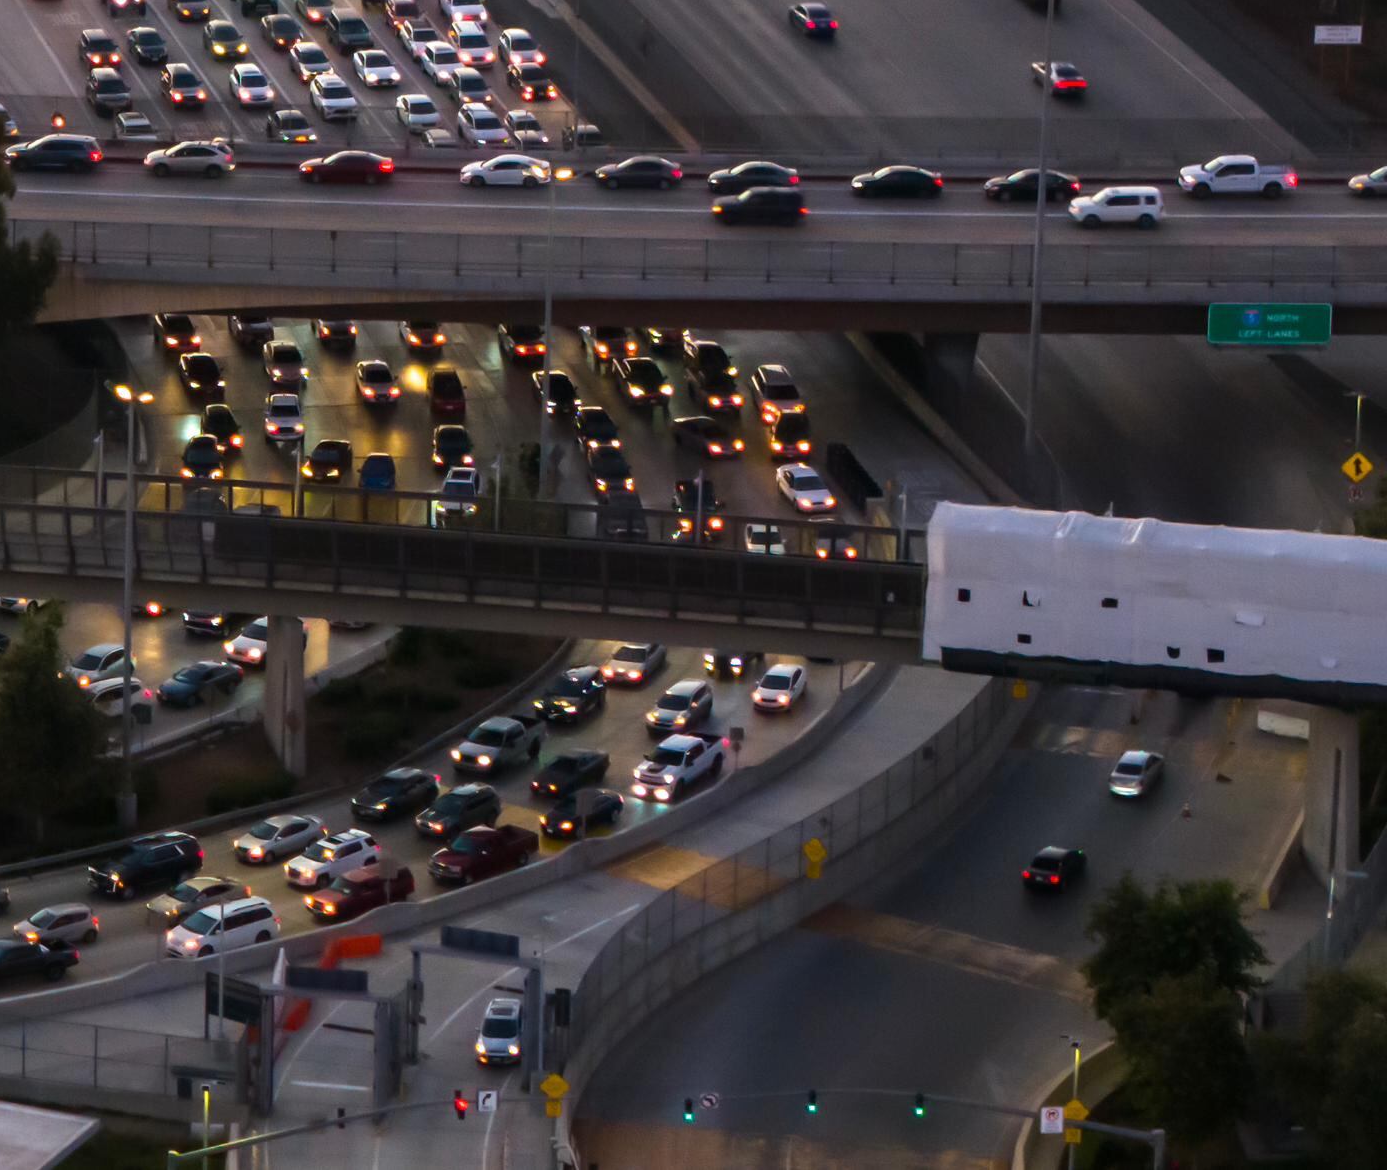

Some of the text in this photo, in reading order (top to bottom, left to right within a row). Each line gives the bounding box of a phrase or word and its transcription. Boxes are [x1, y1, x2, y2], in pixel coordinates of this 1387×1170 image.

[1266, 314, 1300, 323] NORTH
[1239, 330, 1300, 338] LEFT LANES
